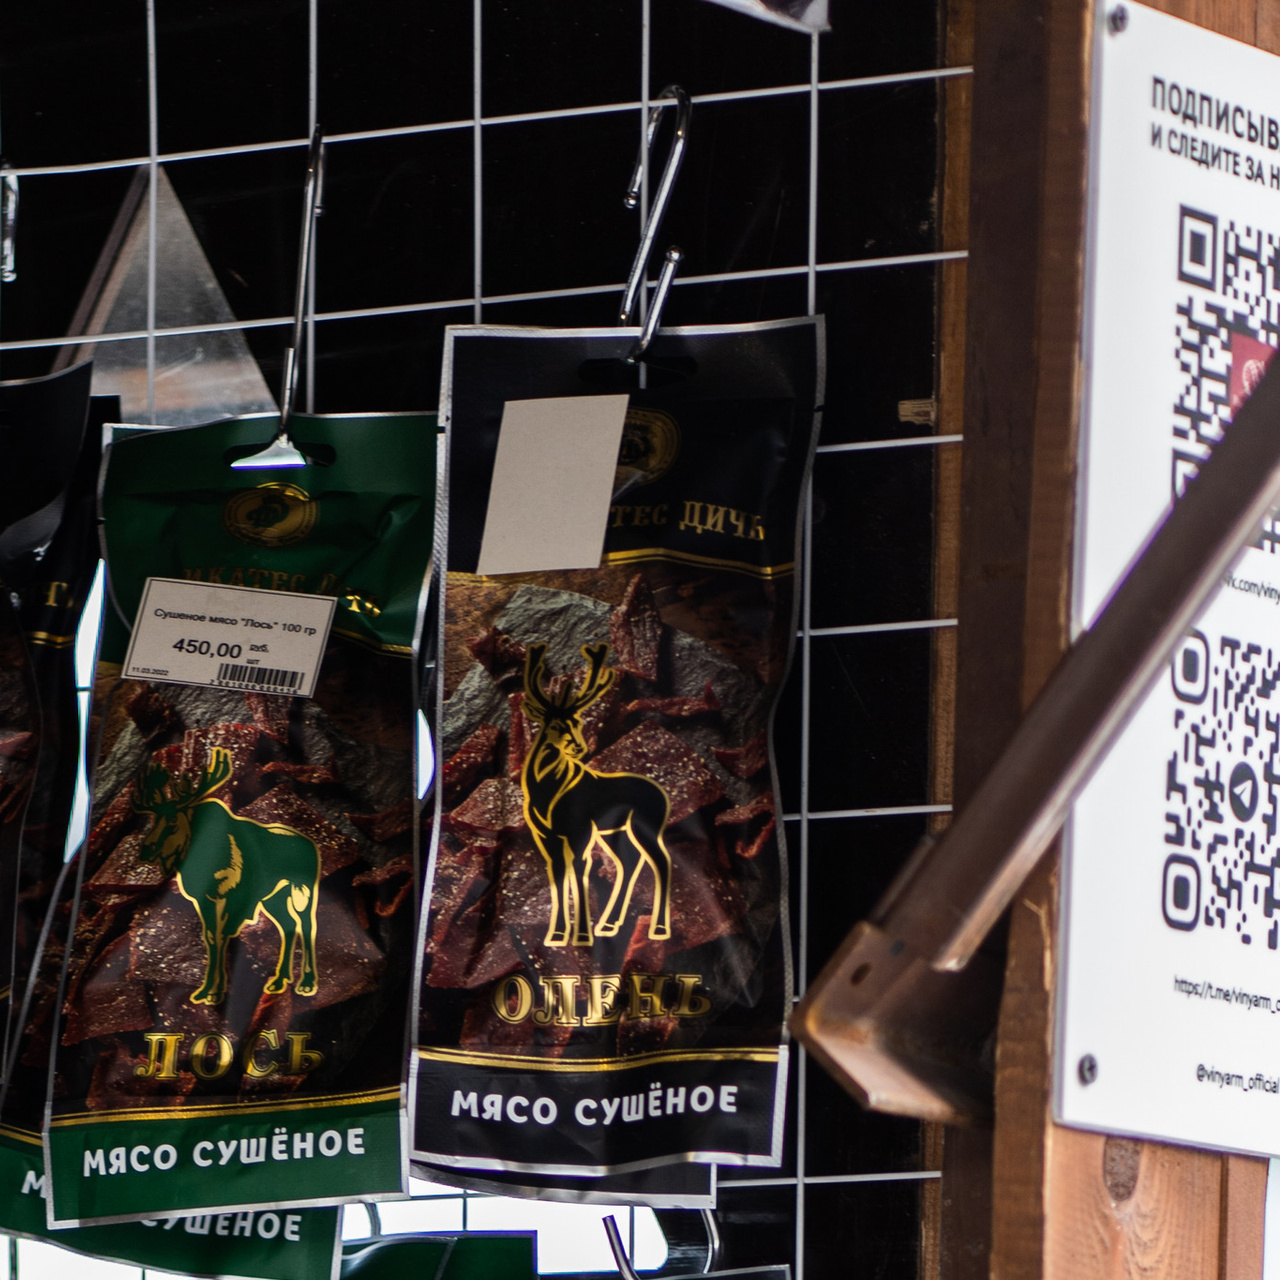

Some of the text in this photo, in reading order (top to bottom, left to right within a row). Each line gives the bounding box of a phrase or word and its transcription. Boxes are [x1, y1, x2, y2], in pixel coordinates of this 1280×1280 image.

[1151, 75, 1280, 152] ПОДПИСЫВ
[1151, 121, 1162, 150] И
[1168, 128, 1241, 177] СЛЕДИТЕ
[1245, 155, 1266, 186] ЗА
[678, 500, 767, 542] ДИЧЬ
[154, 608, 317, 636] Сушеное мясо "Лось" 100 гр
[172, 638, 243, 659] 450,00
[491, 971, 713, 1028] ОЛЕНЬ
[133, 1028, 324, 1080] ЛОСЬ
[450, 1081, 739, 1127] МЯСО СУШЁНОЕ
[83, 1127, 366, 1178] МЯСО СУШЁНОЕ
